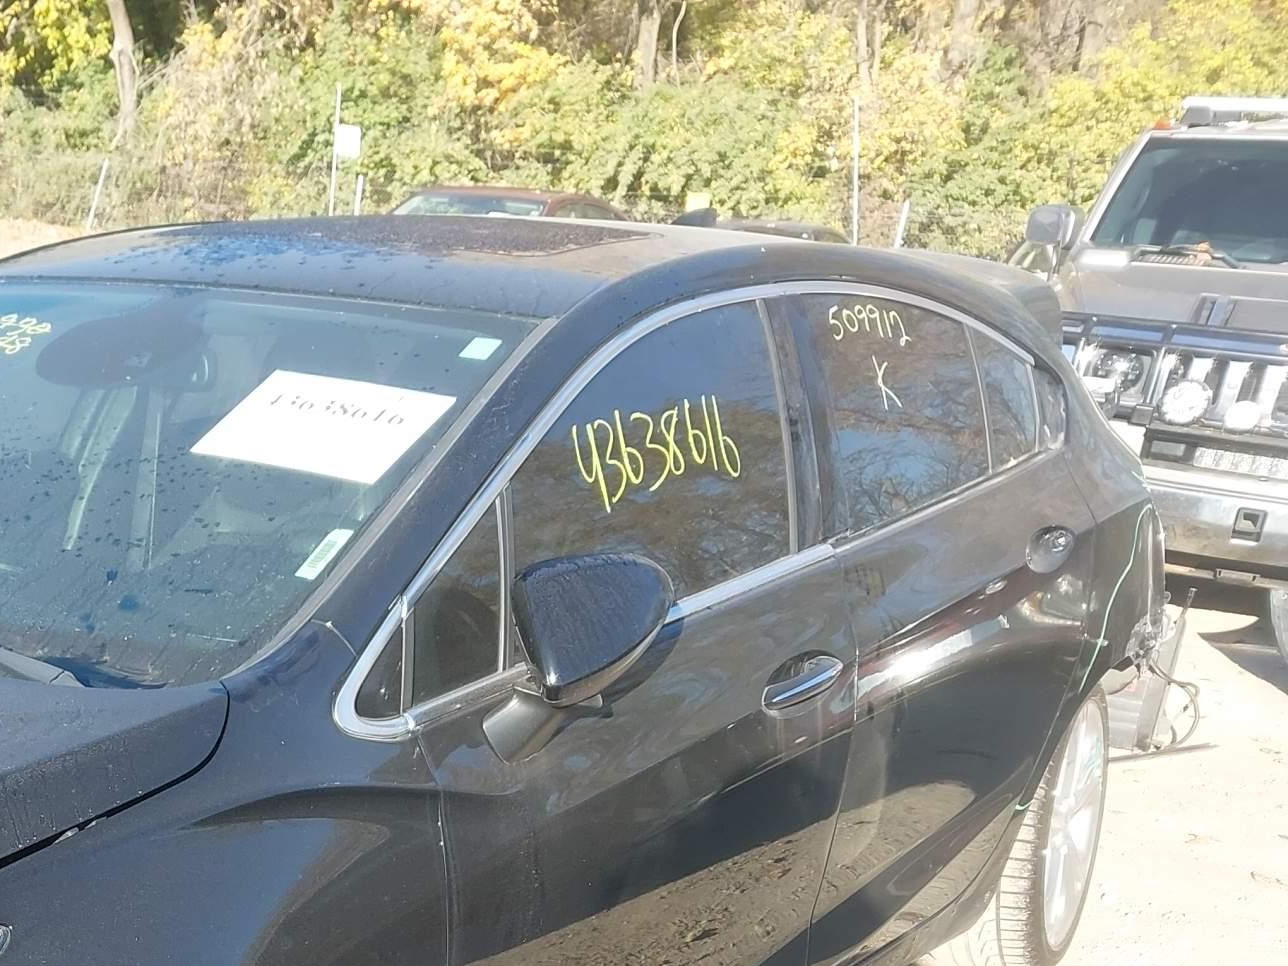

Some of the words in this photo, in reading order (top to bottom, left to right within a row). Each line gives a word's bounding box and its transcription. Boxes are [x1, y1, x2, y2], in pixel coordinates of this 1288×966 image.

[827, 304, 911, 346] 509912
[871, 355, 903, 411] K
[571, 394, 741, 513] 43638616
